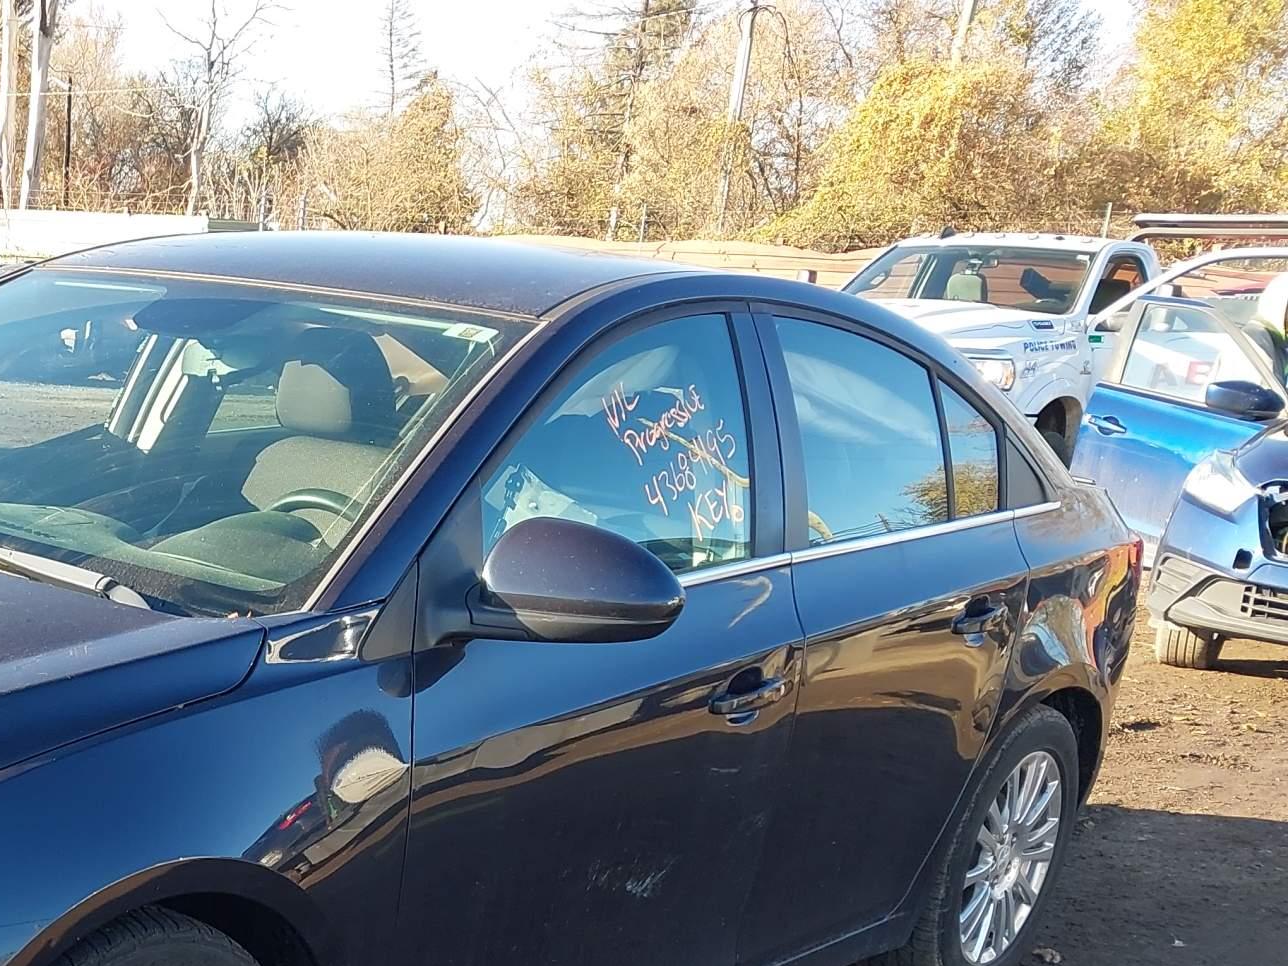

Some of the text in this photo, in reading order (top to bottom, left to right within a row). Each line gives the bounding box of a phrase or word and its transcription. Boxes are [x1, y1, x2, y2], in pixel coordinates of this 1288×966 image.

[1023, 340, 1049, 353] POLICE
[1051, 339, 1078, 351] TOWING
[645, 419, 736, 516] 43684195
